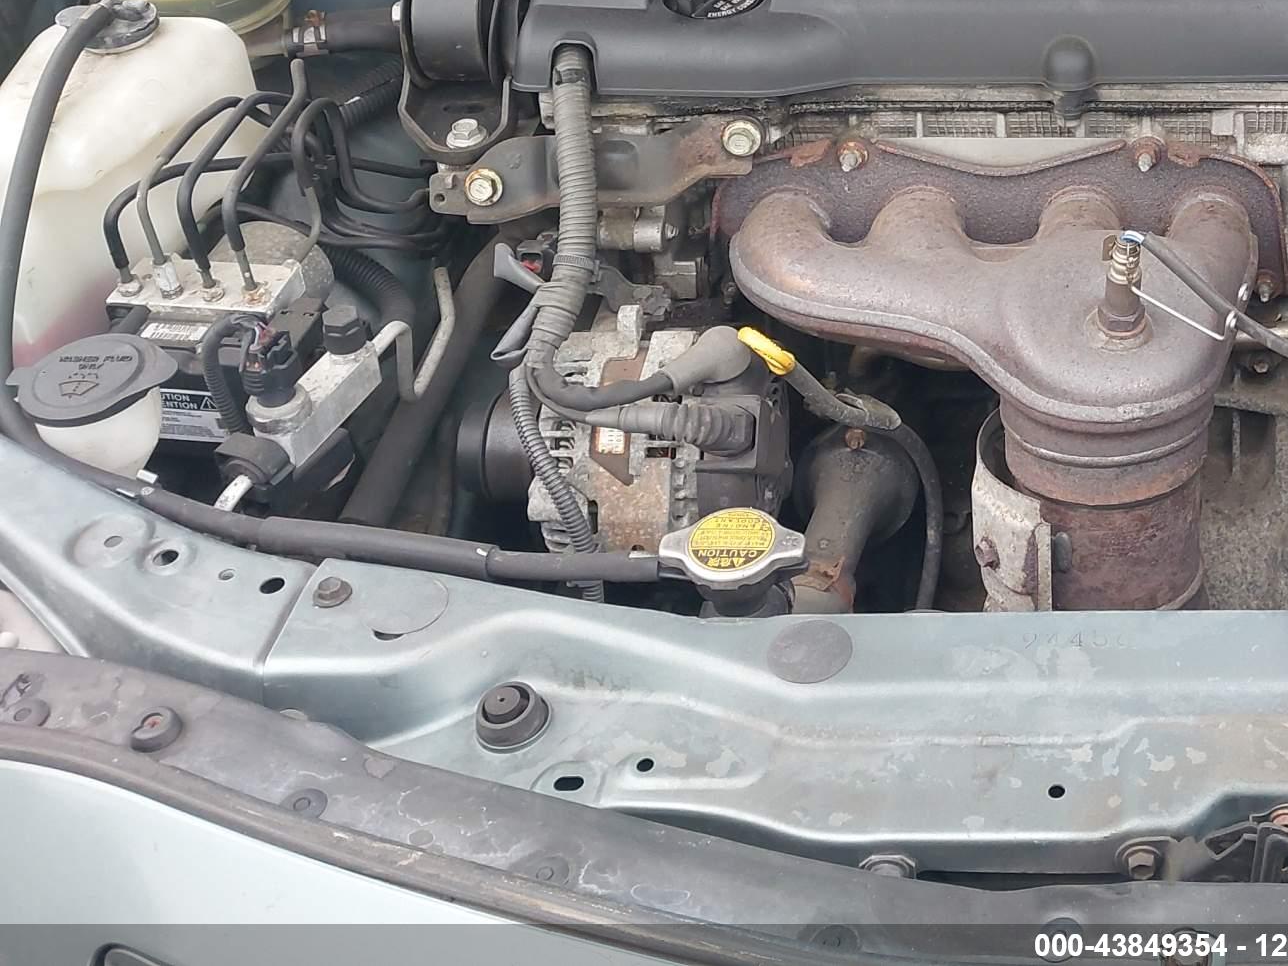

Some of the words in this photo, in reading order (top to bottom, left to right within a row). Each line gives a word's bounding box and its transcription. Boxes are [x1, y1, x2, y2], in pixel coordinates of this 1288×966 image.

[161, 393, 190, 402] UTION
[161, 401, 198, 410] ENTION
[698, 549, 758, 558] CAUTION
